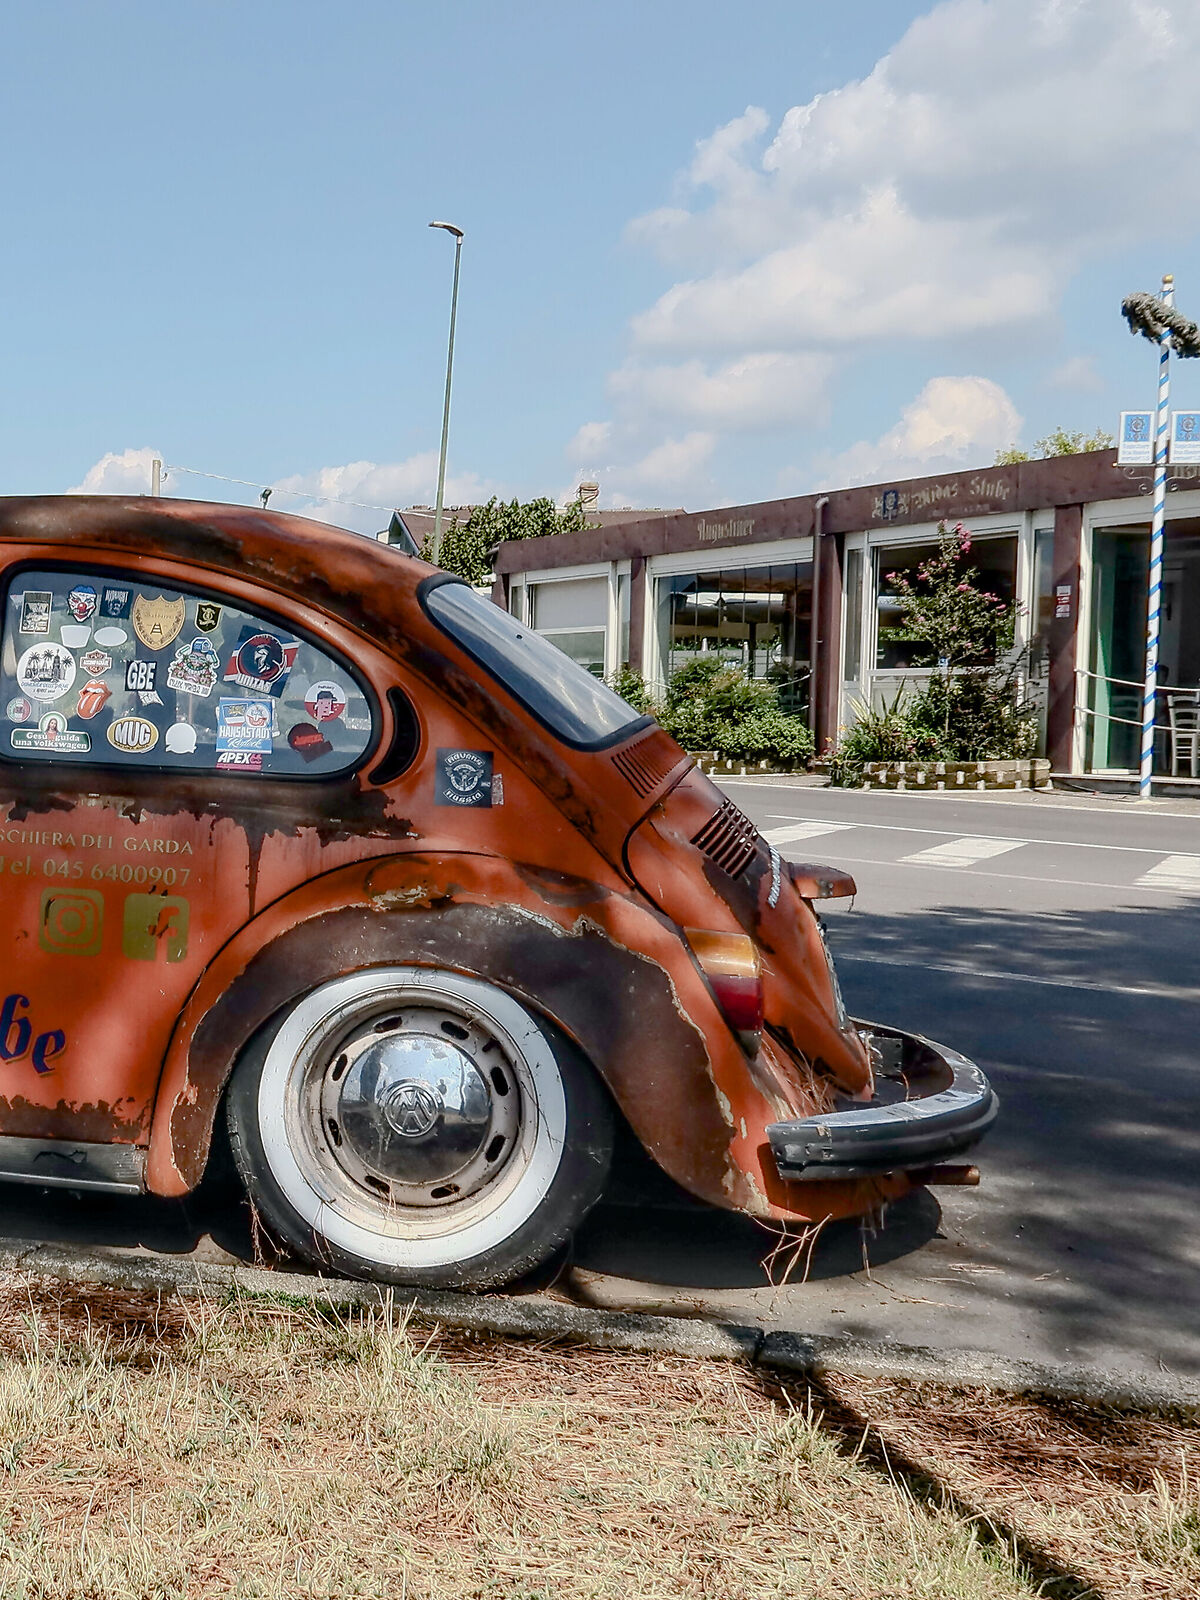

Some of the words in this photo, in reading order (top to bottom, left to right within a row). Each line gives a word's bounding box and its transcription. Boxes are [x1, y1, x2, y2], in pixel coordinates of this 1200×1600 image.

[126, 661, 157, 690] GBE
[55, 733, 80, 742] guida
[114, 721, 151, 747] MUG
[219, 725, 271, 739] HANSASTADT
[123, 837, 193, 855] GARDA
[43, 859, 84, 879] 045
[90, 863, 191, 887] 6400907
